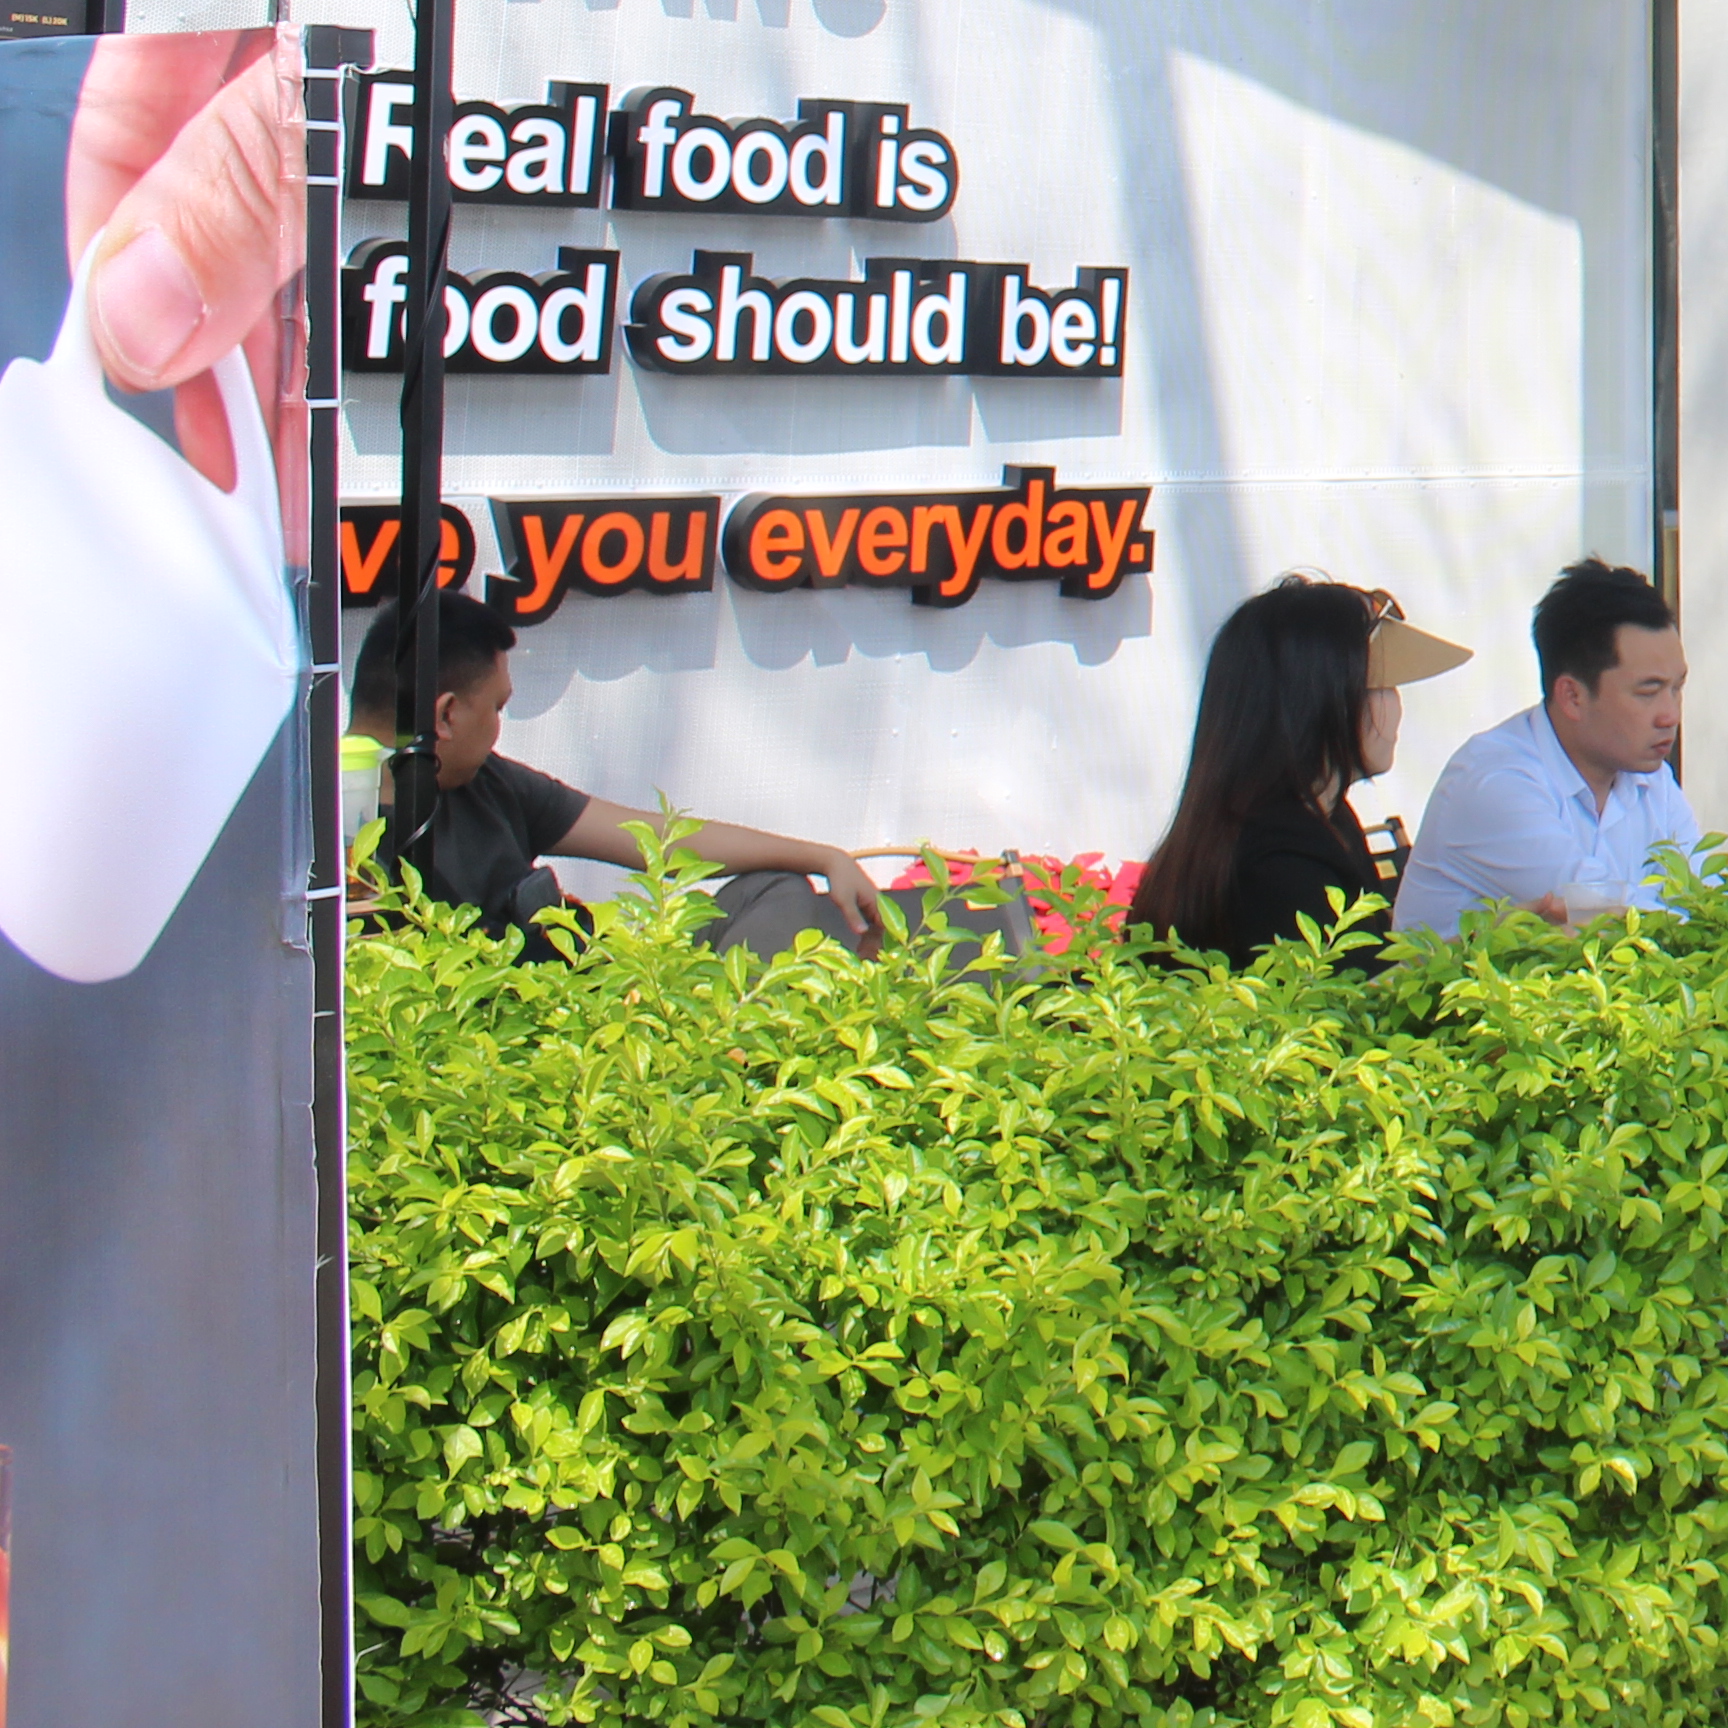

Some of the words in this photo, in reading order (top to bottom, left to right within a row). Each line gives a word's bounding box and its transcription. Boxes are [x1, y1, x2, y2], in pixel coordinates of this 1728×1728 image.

[638, 90, 843, 207] food
[876, 115, 948, 212] is
[656, 266, 965, 365] should
[1001, 275, 1121, 367] be!
[516, 511, 706, 614] you
[749, 479, 1146, 598] everyday.
